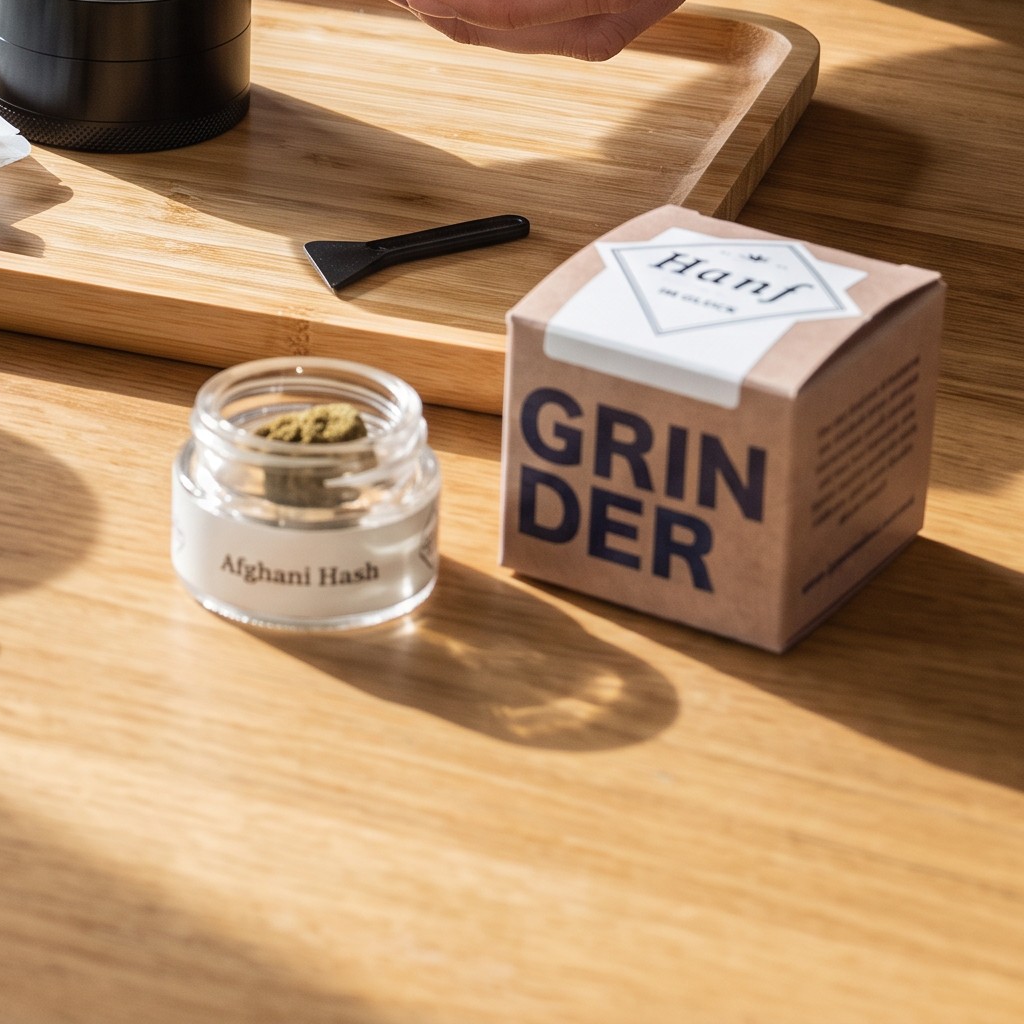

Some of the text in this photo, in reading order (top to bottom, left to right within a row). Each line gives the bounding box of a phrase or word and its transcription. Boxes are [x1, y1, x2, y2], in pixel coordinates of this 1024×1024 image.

[648, 251, 815, 305] Hanf
[519, 386, 767, 524] GRIN
[220, 553, 380, 587] Afghani Hash
[517, 464, 715, 595] DER
